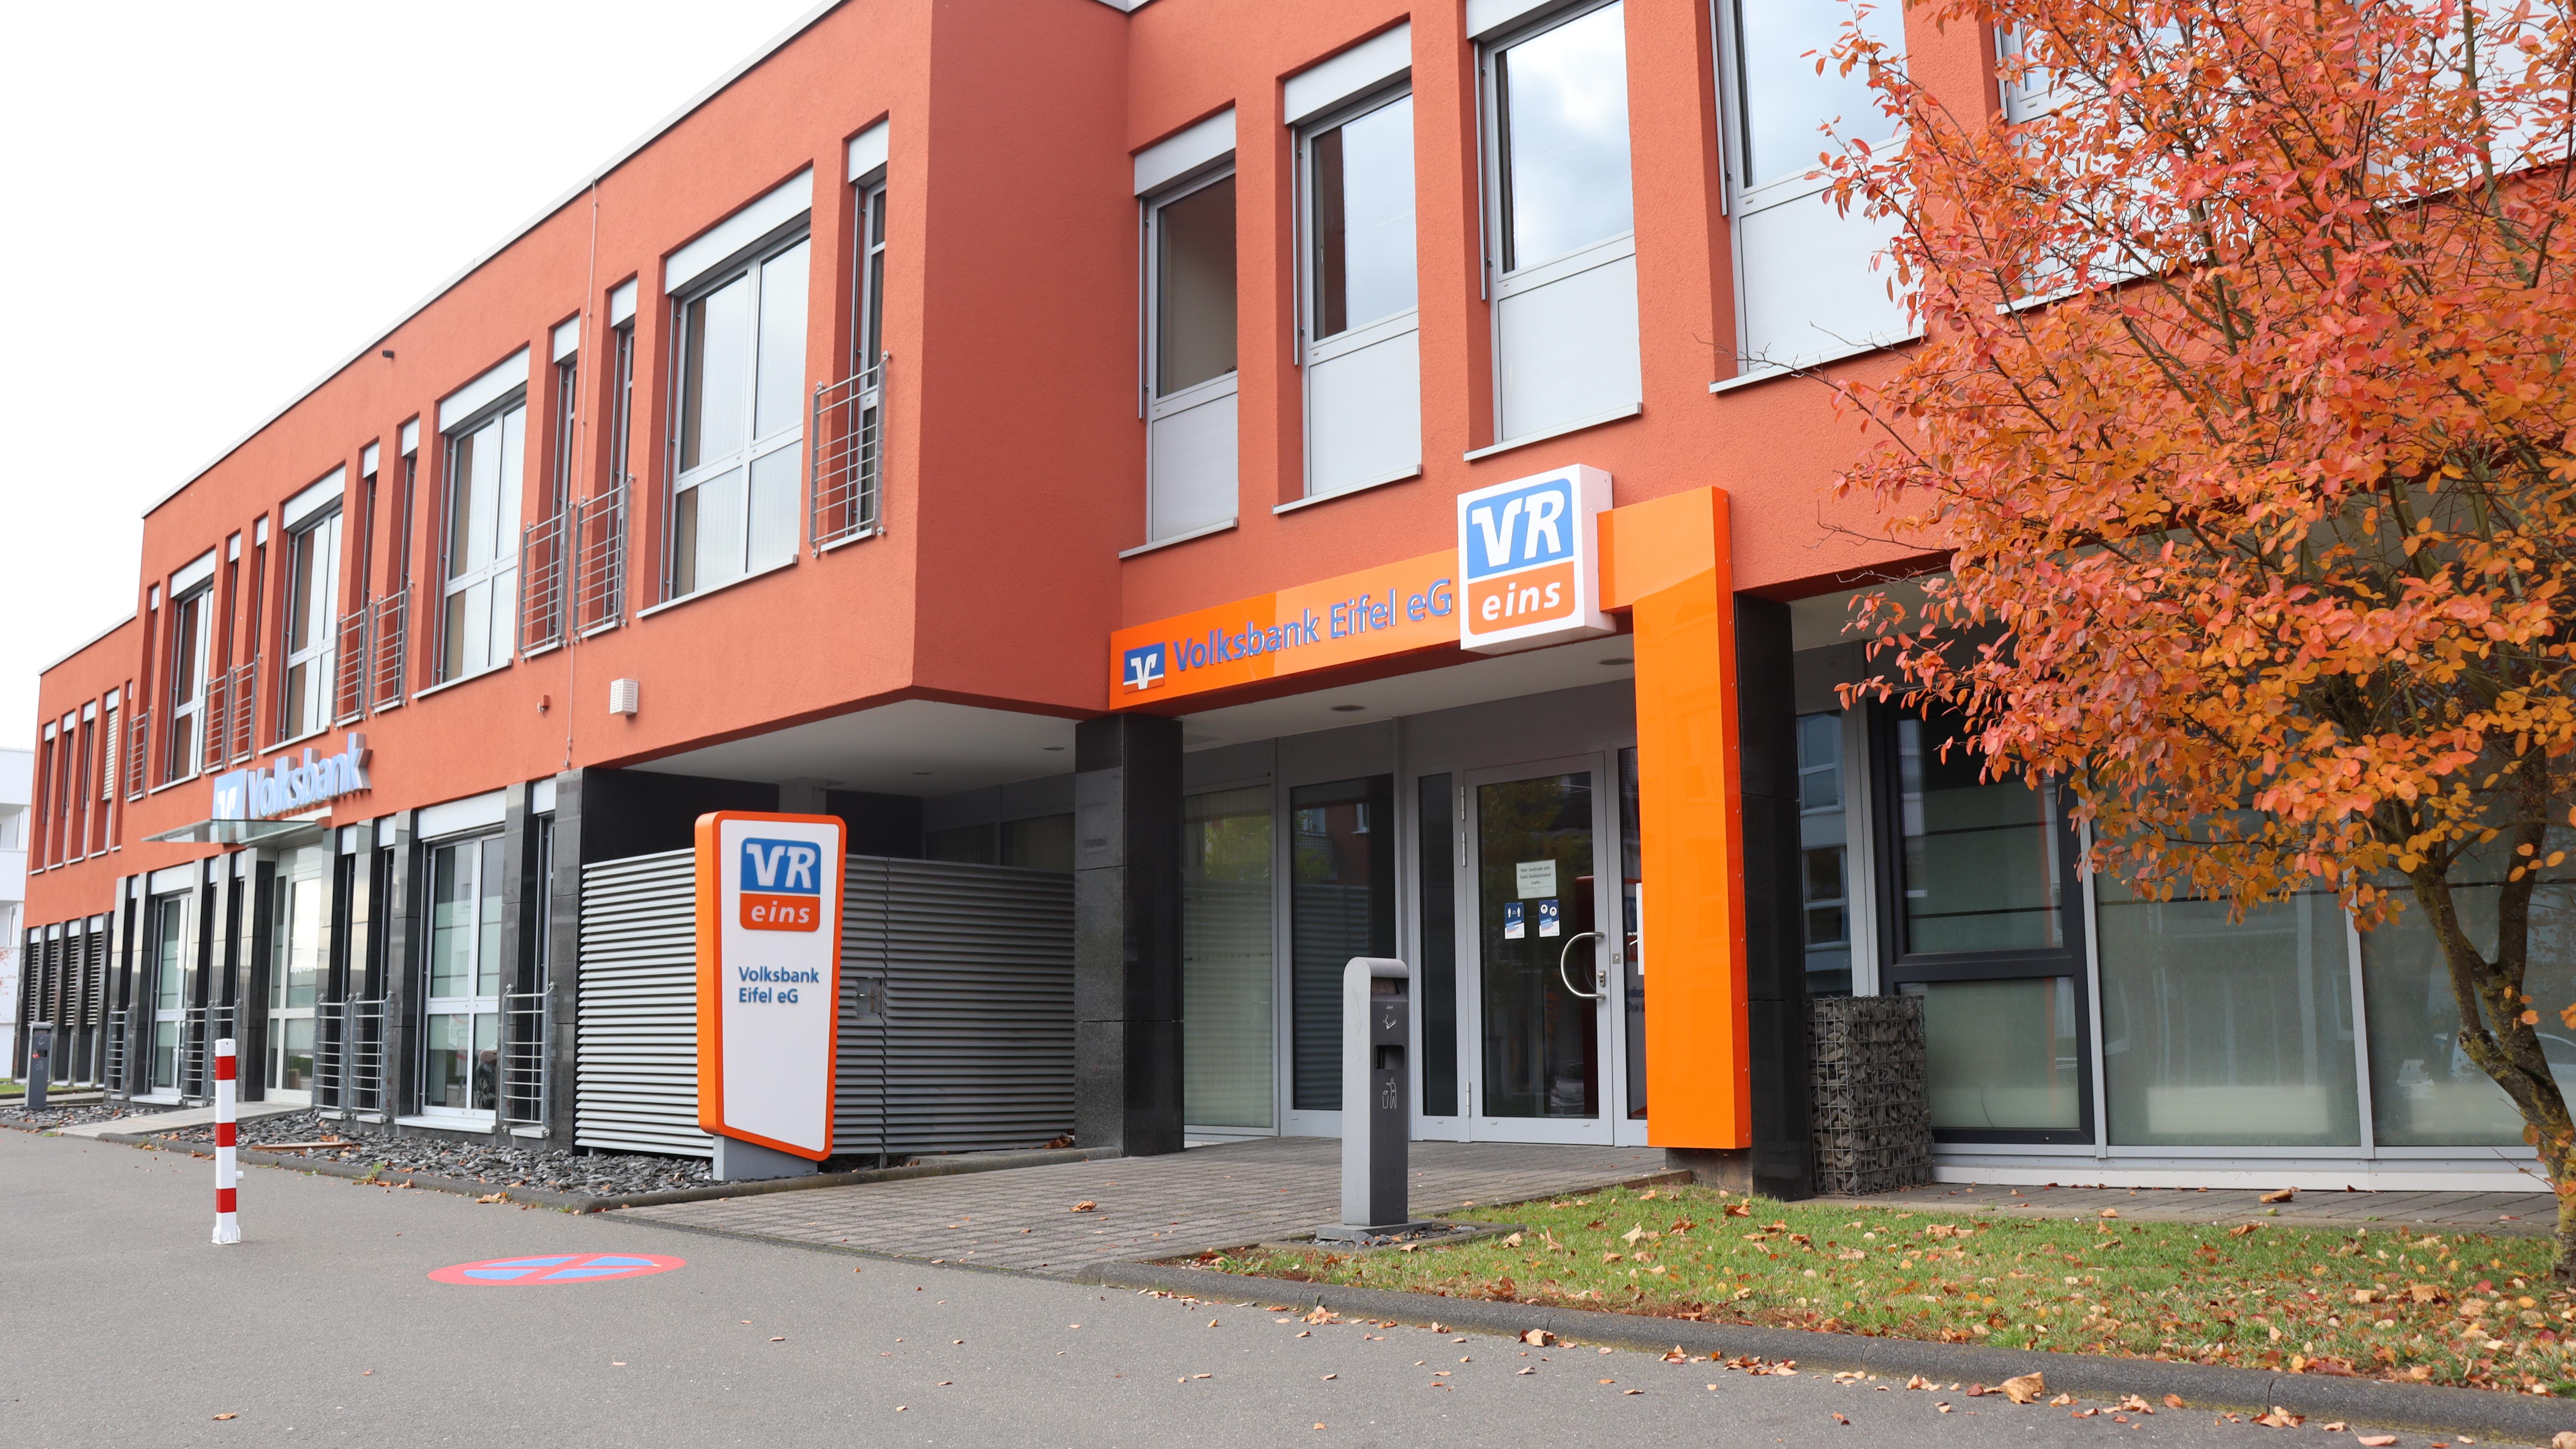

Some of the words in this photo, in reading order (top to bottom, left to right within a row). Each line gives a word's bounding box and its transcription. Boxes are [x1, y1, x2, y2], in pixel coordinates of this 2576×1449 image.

[1472, 489, 1565, 568] VR
[1482, 582, 1561, 621] eins
[1173, 607, 1320, 671] Volksbank
[1331, 588, 1396, 639] Eifel
[1406, 578, 1452, 621] eG
[248, 732, 368, 820] Volksbank
[746, 843, 816, 889] VR
[751, 900, 811, 924] eins
[739, 966, 820, 983] Volksbank
[739, 987, 772, 1003] Eifel
[777, 988, 799, 1003] eG
